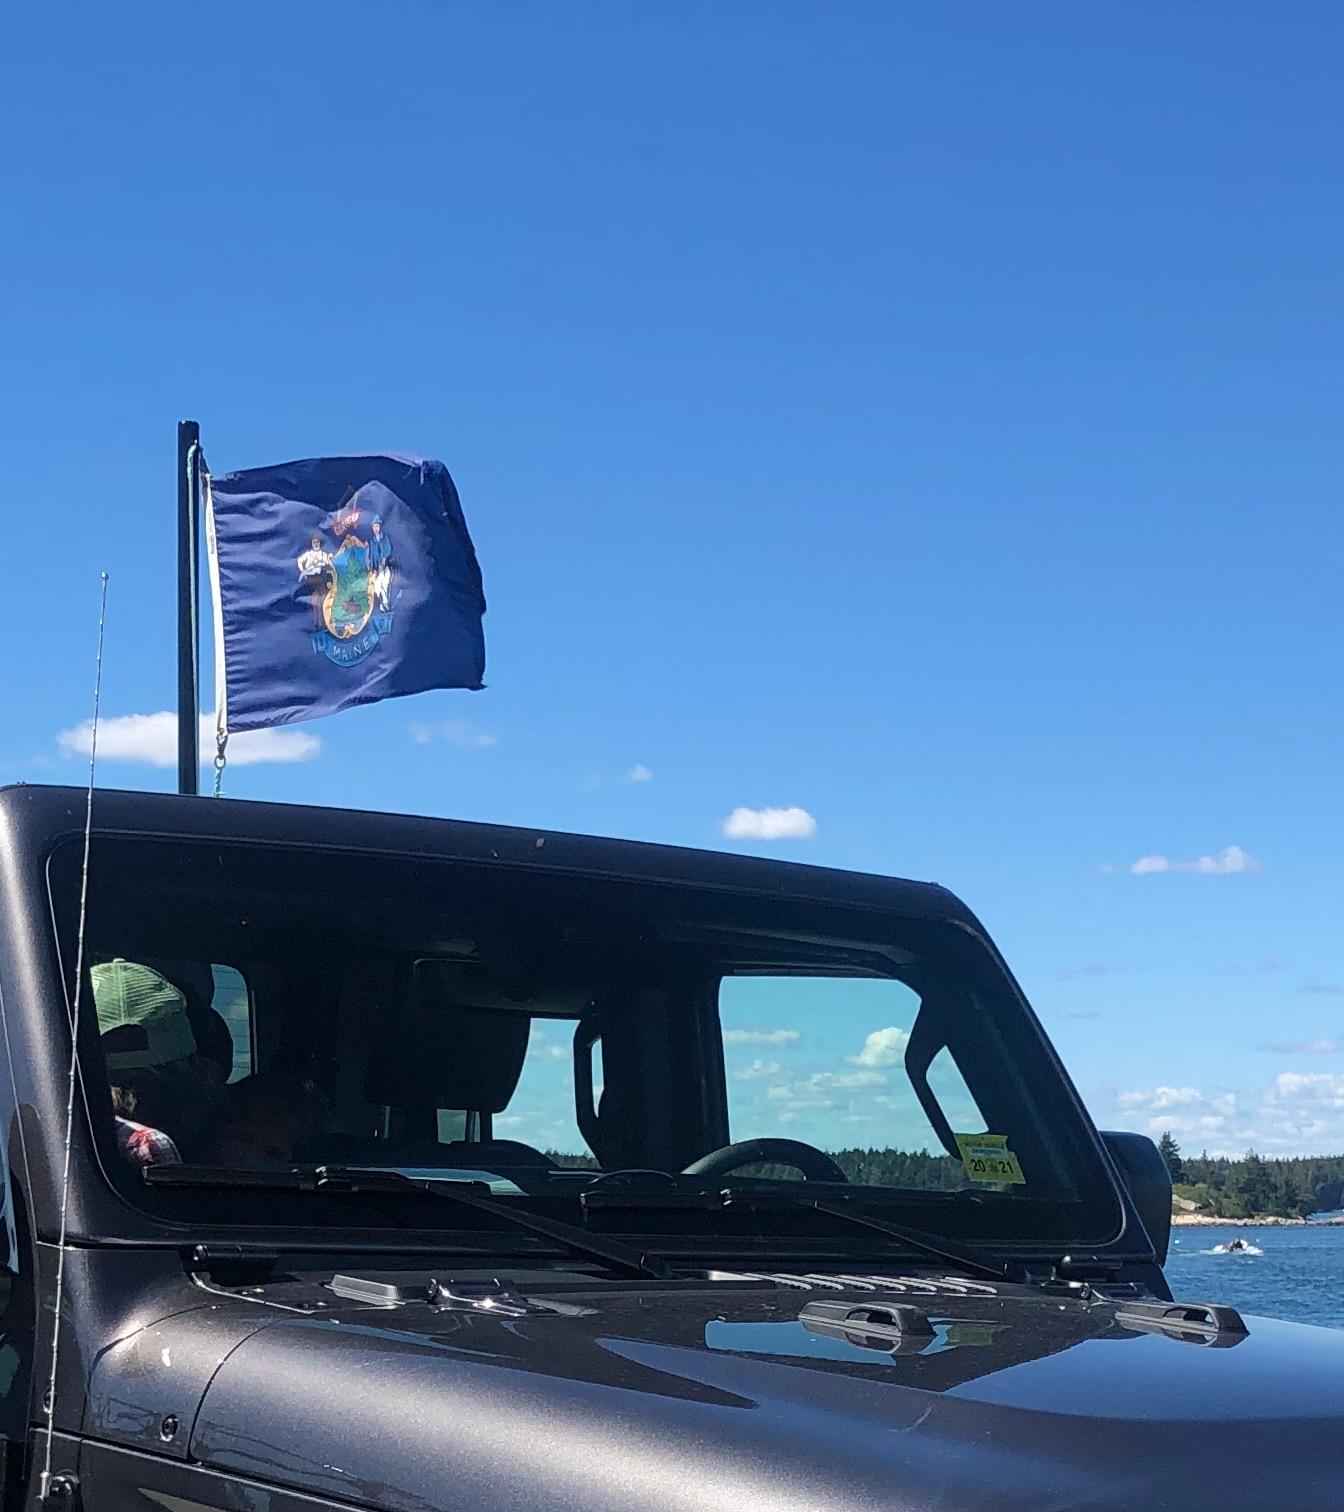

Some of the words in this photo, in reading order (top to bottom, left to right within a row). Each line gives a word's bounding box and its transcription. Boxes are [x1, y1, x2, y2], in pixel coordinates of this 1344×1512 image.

[333, 637, 369, 660] MAINE
[971, 1159, 986, 1172] 20
[999, 1161, 1014, 1173] 21
